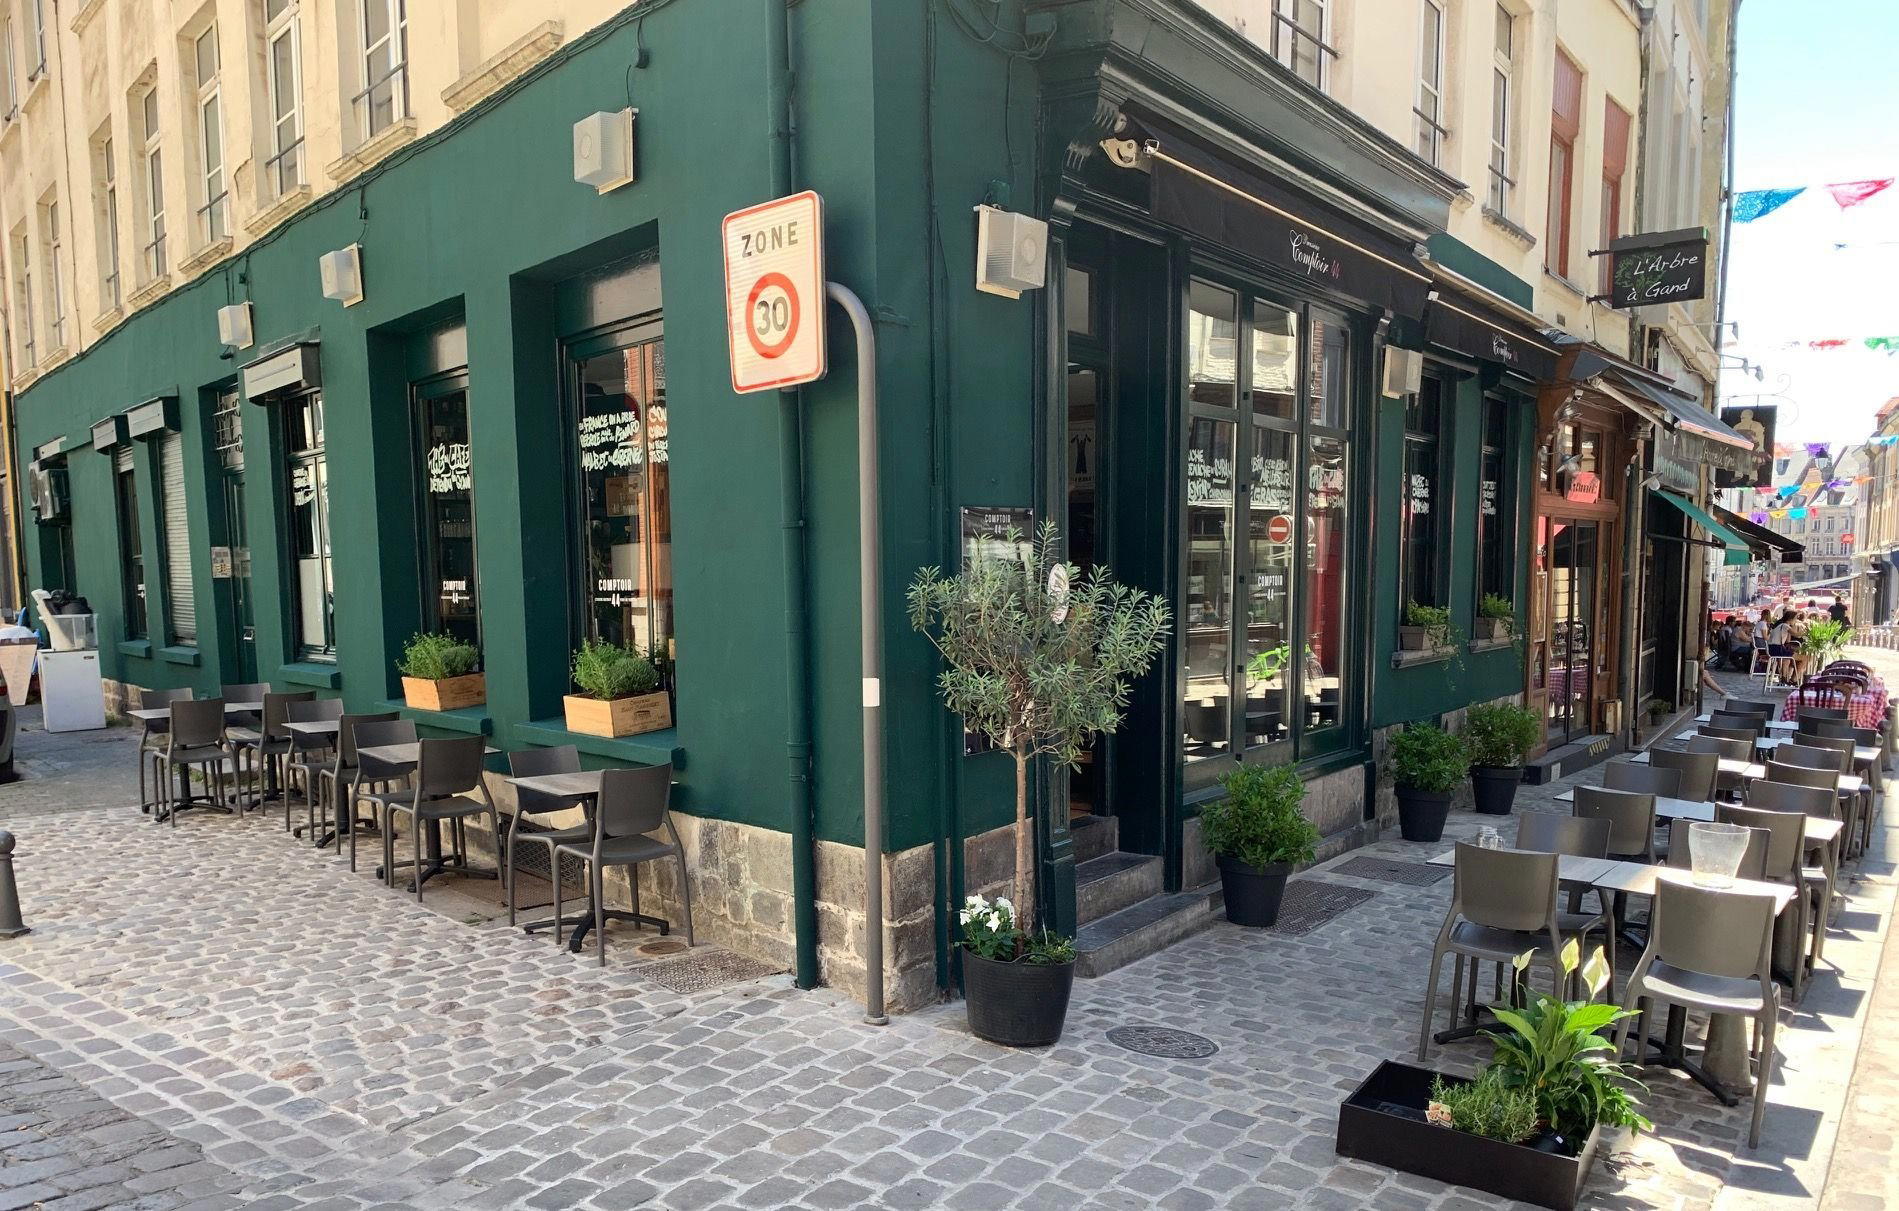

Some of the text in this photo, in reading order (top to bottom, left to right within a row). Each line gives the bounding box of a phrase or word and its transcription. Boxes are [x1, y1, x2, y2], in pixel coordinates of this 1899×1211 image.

[741, 221, 799, 258] ZONE
[1633, 251, 1699, 276] L'Arbre
[1627, 277, 1691, 301] à Gand
[756, 296, 788, 335] 30
[582, 414, 609, 434] FRANCE
[984, 514, 1011, 523] COMPTOIR
[598, 579, 632, 591] COMPTOIR
[1258, 575, 1283, 587] COMPTOIR
[611, 593, 620, 607] 44
